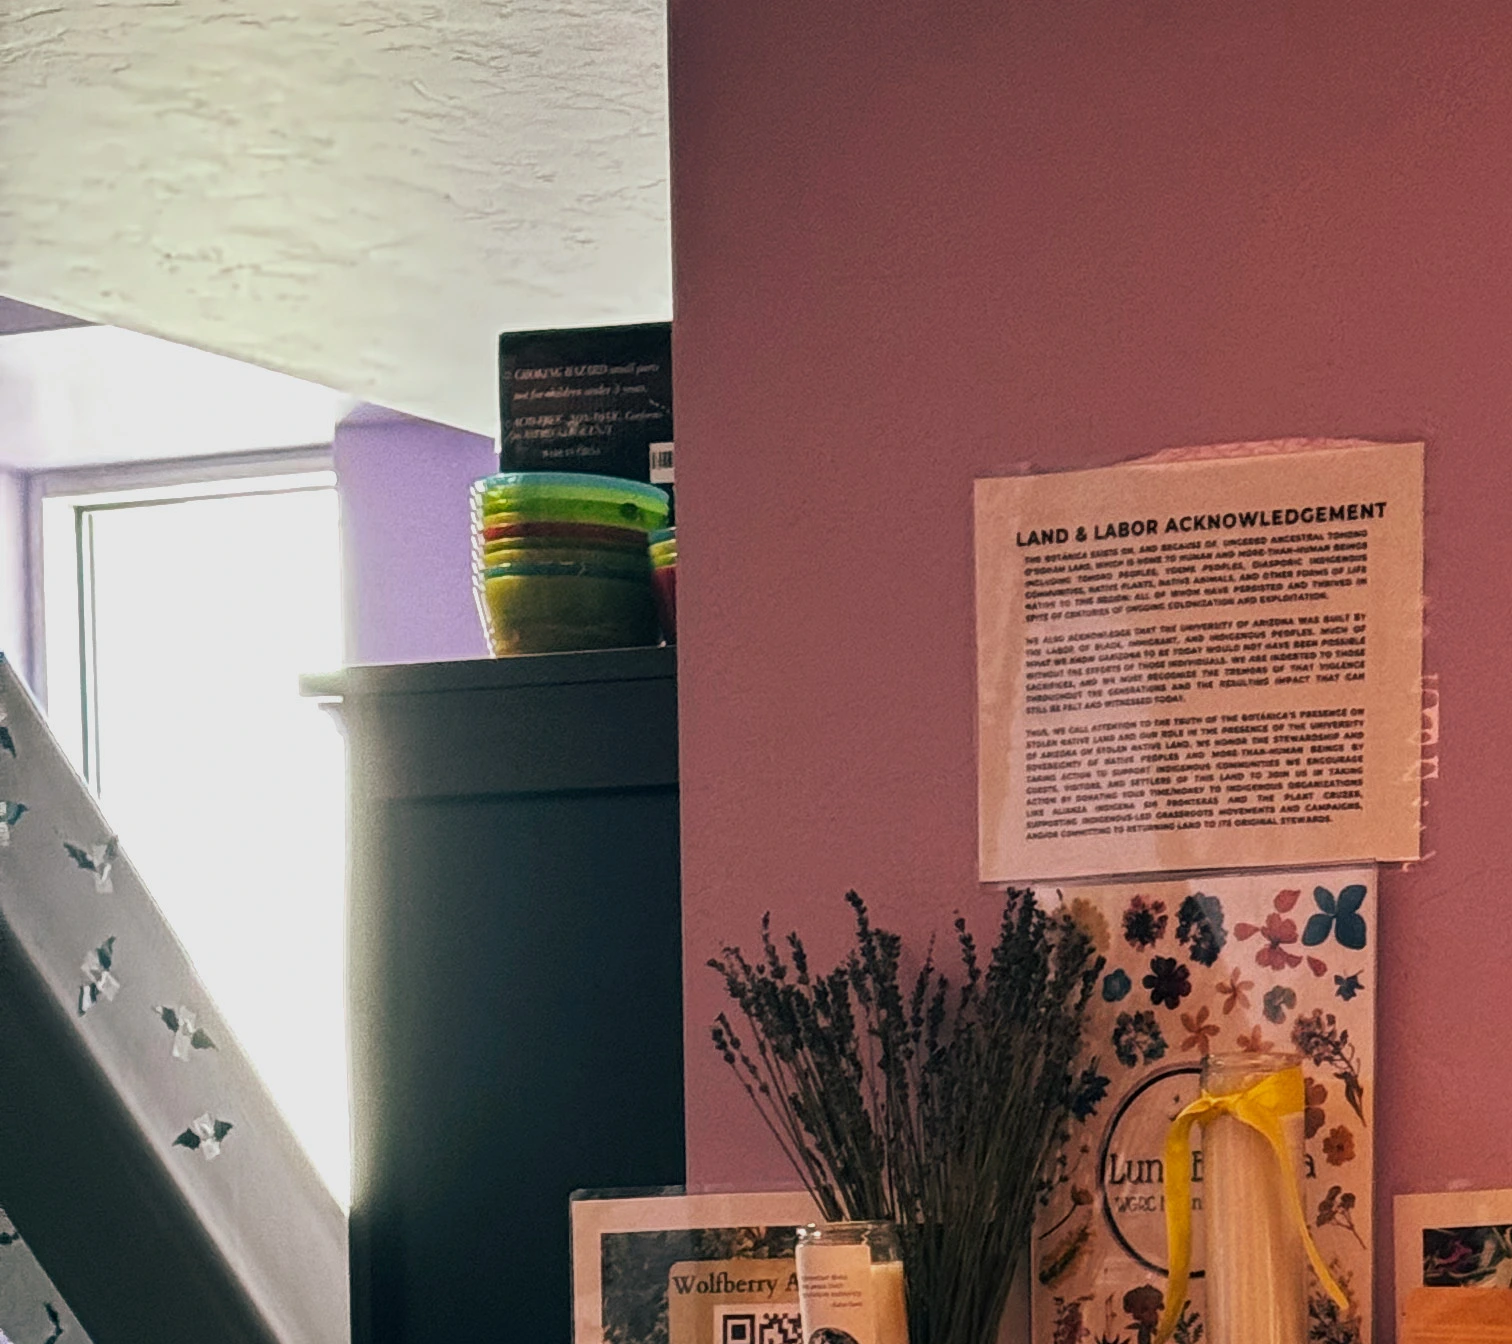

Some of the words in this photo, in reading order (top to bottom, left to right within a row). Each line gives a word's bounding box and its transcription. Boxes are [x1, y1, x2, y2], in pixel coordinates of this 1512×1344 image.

[1015, 528, 1068, 547] LAND
[1075, 526, 1087, 542] &
[1093, 519, 1158, 540] LABOR
[1164, 501, 1388, 535] ACKNOWLEDGEMENT
[1108, 1152, 1165, 1185] Lun
[671, 1271, 778, 1298] Wolfberry
